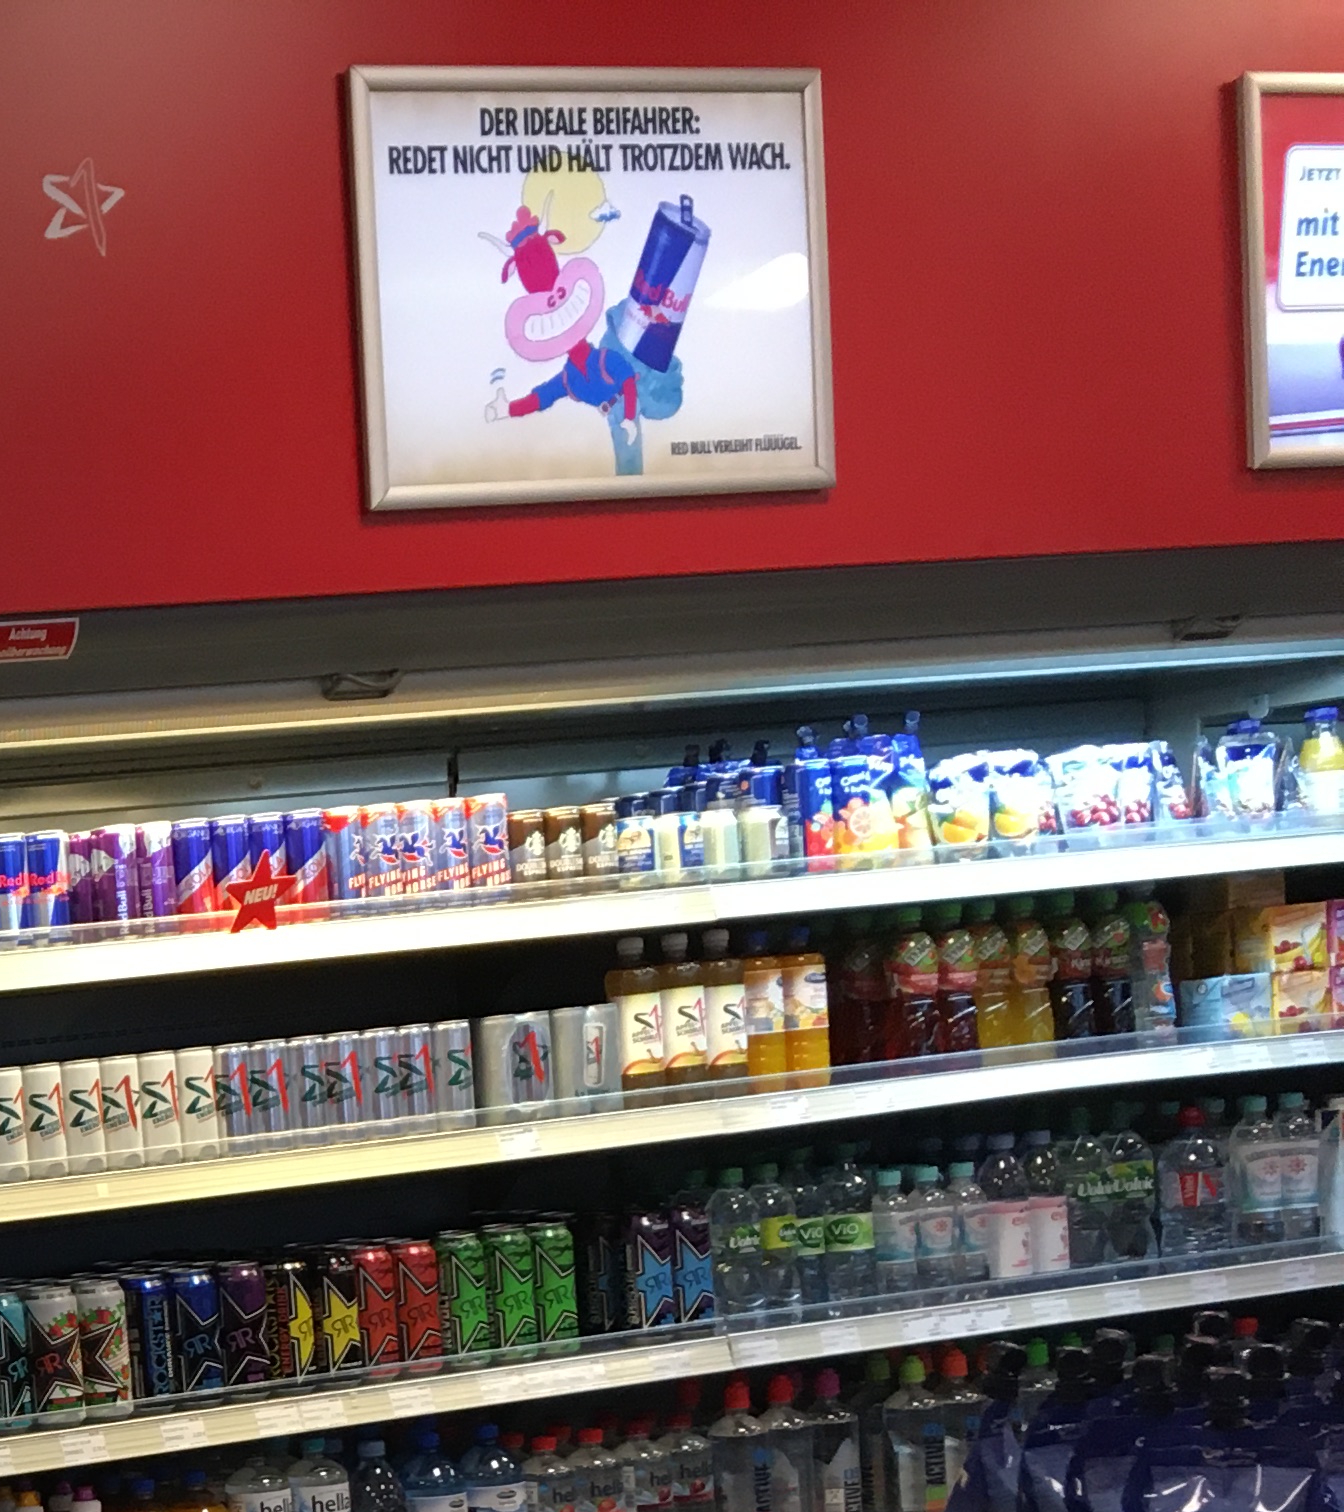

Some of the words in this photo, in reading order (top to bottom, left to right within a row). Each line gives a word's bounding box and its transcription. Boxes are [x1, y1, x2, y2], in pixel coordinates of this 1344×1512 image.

[480, 107, 517, 138] DER
[523, 106, 587, 138] IDEALE
[592, 106, 700, 137] BEIFAHRER:
[388, 145, 448, 175] REDET
[452, 144, 513, 174] NICHT
[517, 144, 563, 173] UND
[567, 138, 613, 173] HÄLT
[622, 142, 724, 172] TROTZDEM
[728, 140, 792, 171] WACH.
[1299, 166, 1341, 182] JETZT
[1296, 208, 1339, 237] mit
[671, 441, 689, 455] RED
[690, 440, 713, 454] BULL
[714, 439, 752, 453] VERLEIHT
[7, 627, 48, 644] Achtung
[242, 883, 278, 906] NEU!
